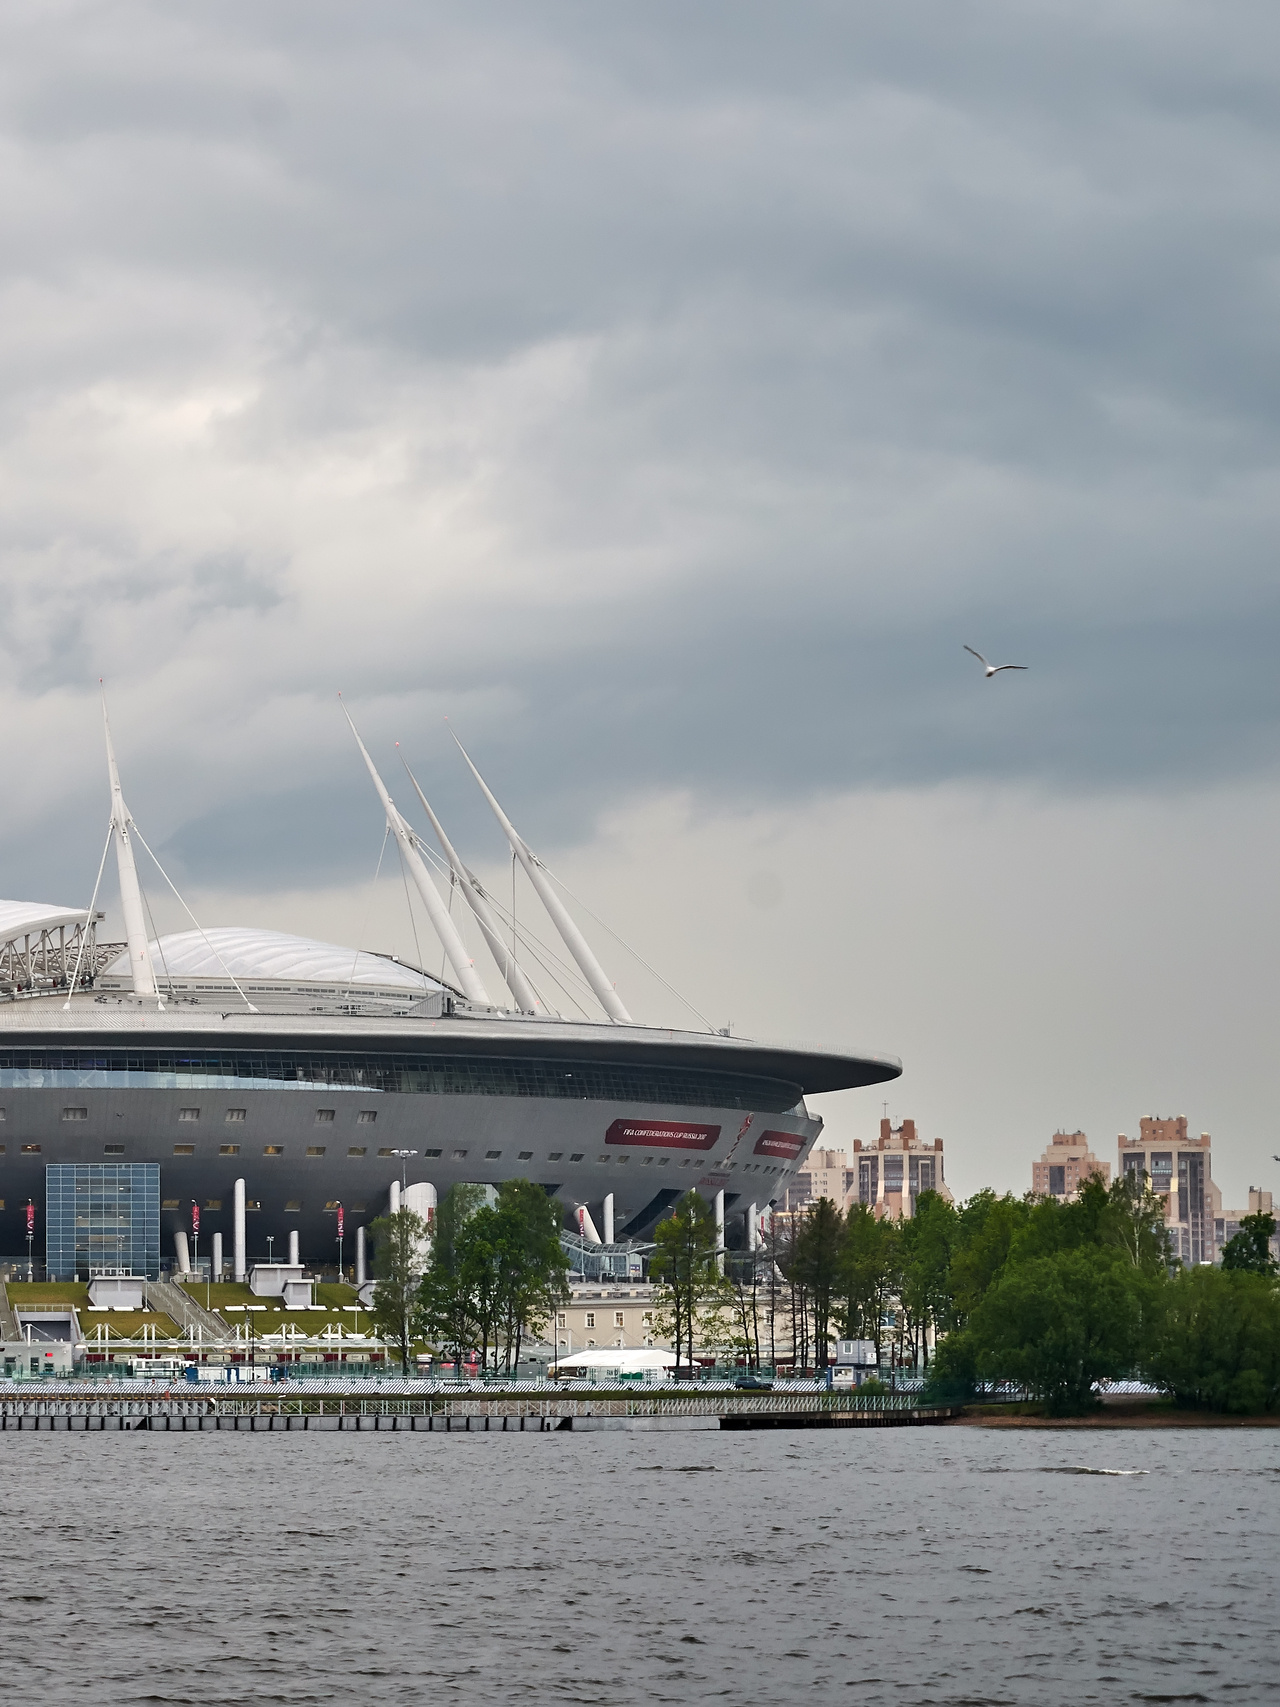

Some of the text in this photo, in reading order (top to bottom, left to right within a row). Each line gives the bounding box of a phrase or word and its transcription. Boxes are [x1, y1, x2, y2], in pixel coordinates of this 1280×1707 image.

[623, 1128, 634, 1136] FIFA
[634, 1129, 674, 1138] CONFEDERATIONS
[682, 1132, 698, 1140] RUSSIA
